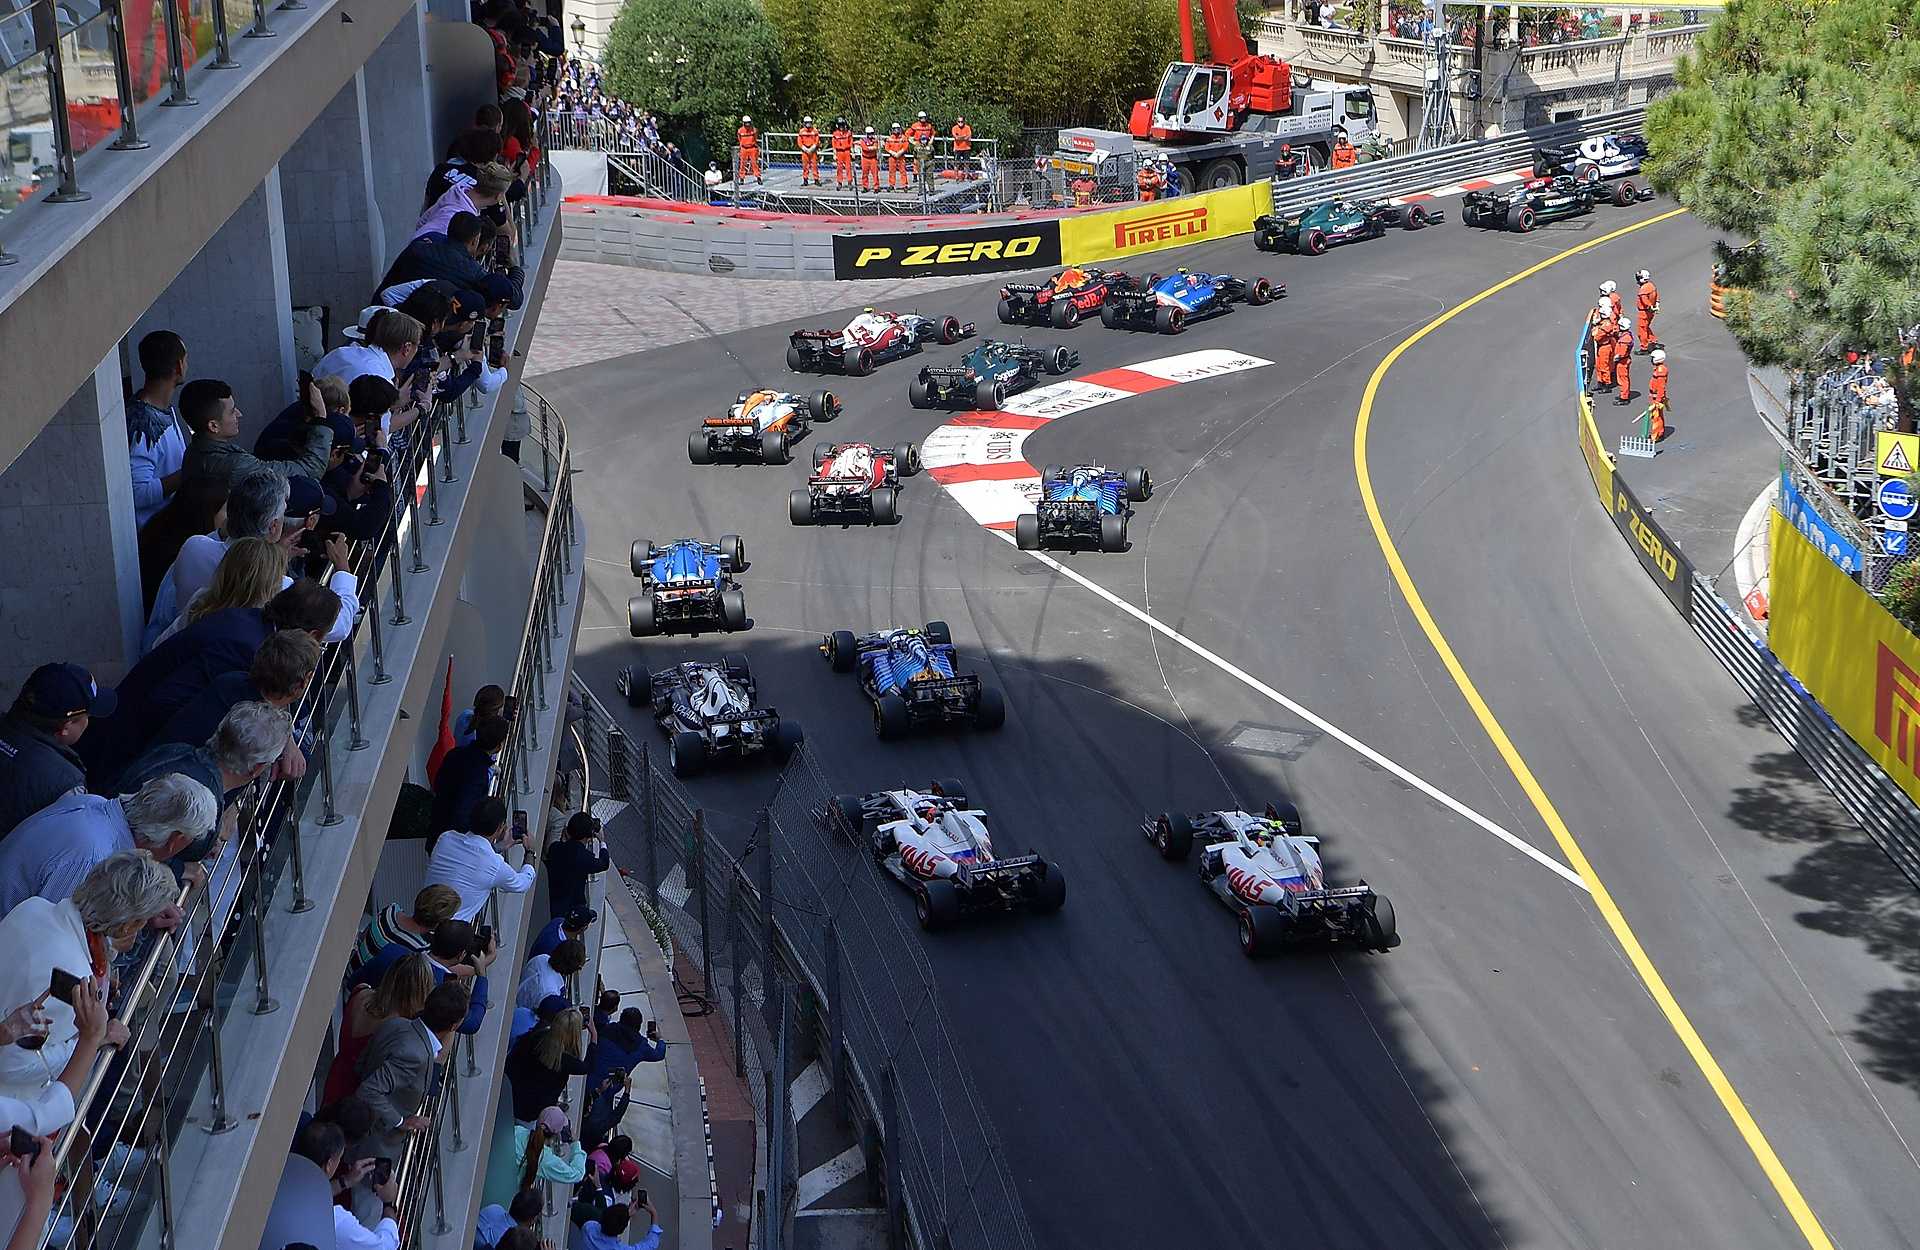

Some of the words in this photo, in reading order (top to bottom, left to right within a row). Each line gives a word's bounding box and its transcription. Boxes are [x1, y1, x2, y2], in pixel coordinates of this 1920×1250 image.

[1114, 207, 1207, 248] PIRELLI
[855, 247, 891, 267] P
[901, 236, 1041, 267] ZERO
[1007, 283, 1041, 292] HONDA
[1053, 291, 1074, 300] HONDA
[986, 440, 1012, 461] UBS
[1044, 501, 1091, 510] SOFINA
[1617, 492, 1629, 513] P
[1628, 508, 1678, 582] ZERO
[656, 580, 713, 588] ALPINE
[713, 709, 768, 721] HONDA
[900, 842, 946, 877] HAAS
[1226, 863, 1274, 902] HAAS
